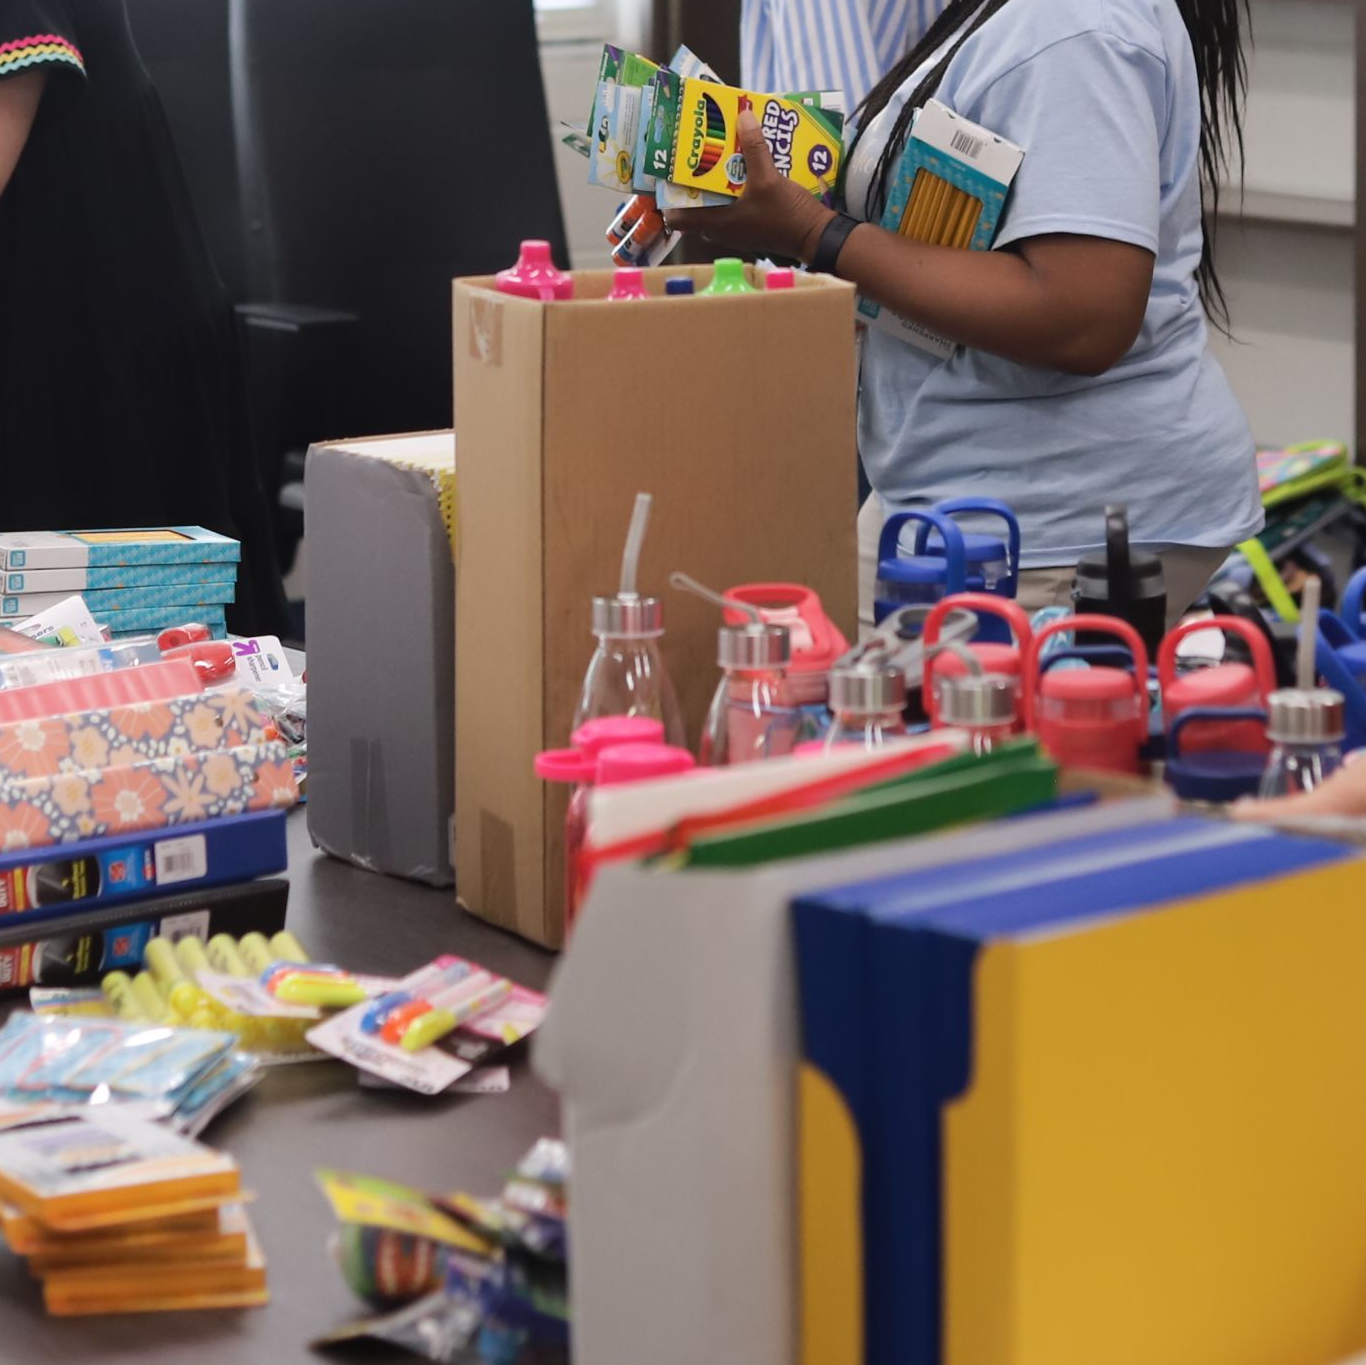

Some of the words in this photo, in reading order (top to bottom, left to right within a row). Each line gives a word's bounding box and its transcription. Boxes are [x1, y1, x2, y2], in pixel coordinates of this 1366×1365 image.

[686, 98, 708, 171] Crayola
[653, 149, 667, 170] 12
[811, 150, 828, 171] 12
